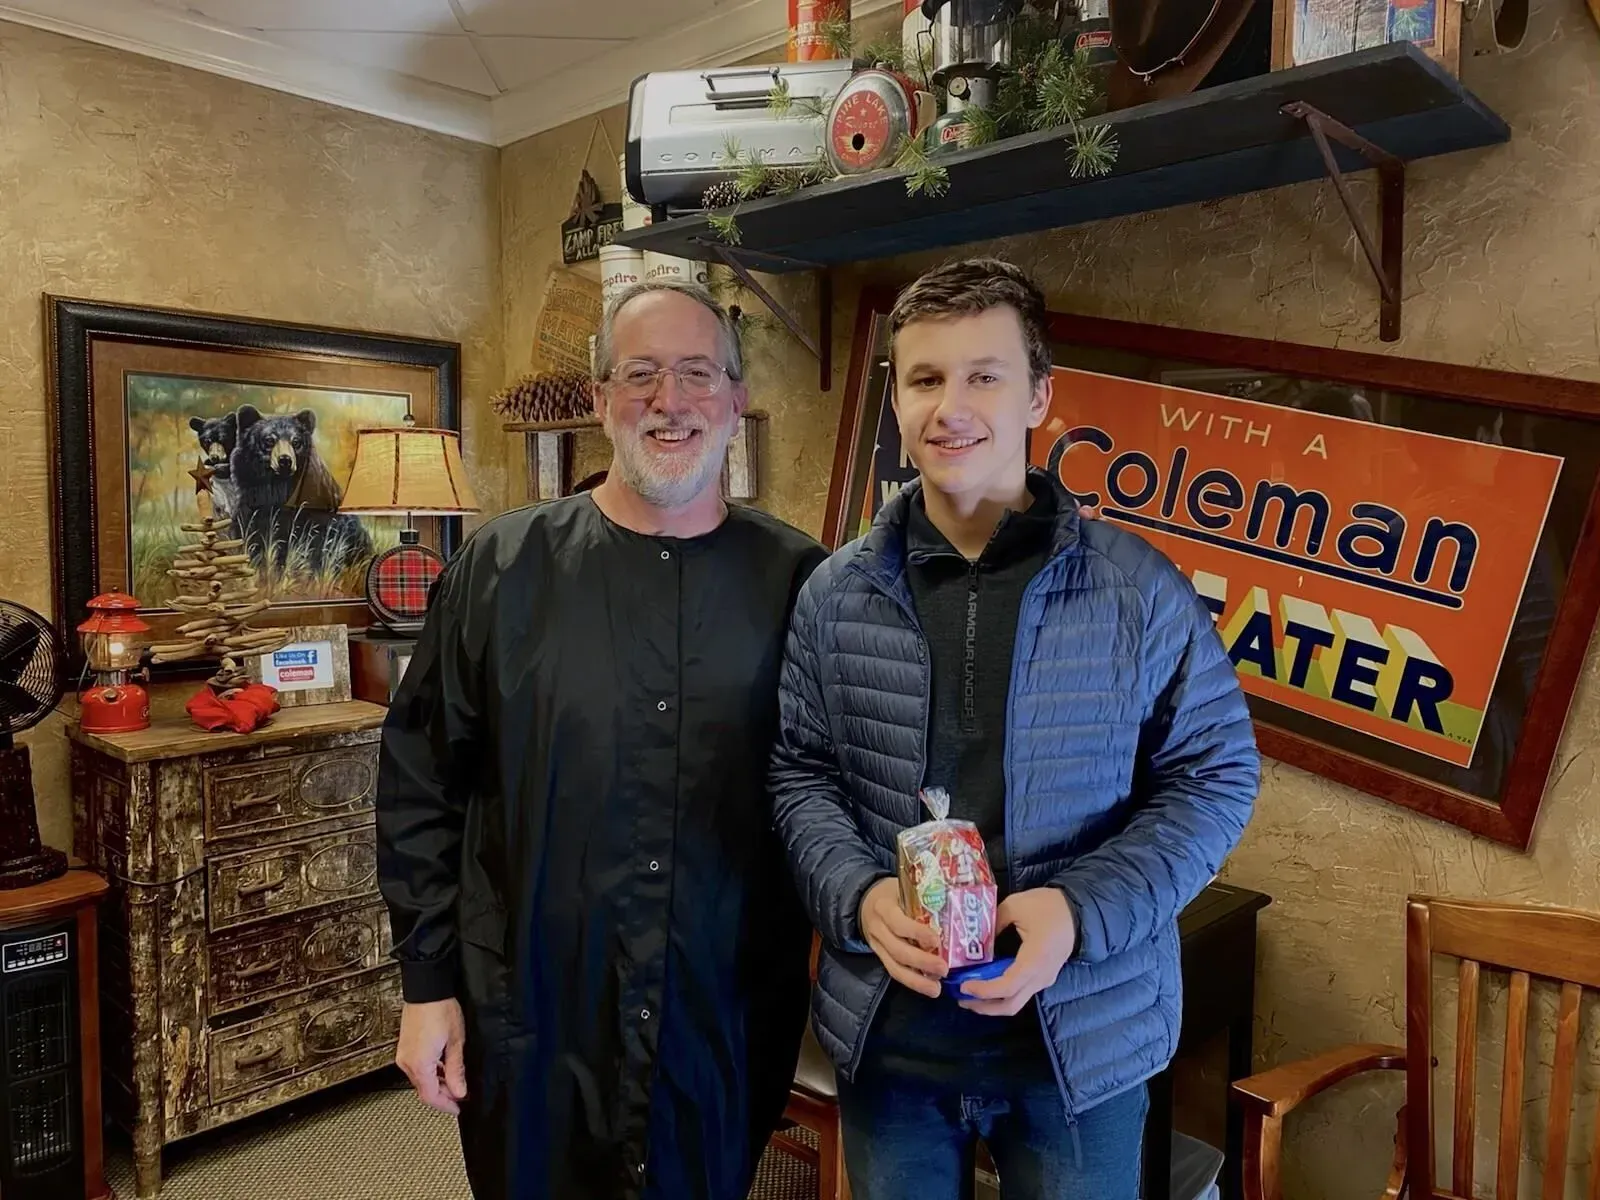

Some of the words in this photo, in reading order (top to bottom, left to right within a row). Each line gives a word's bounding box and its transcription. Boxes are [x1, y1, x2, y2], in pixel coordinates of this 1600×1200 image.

[837, 94, 860, 124] PINE
[865, 92, 888, 125] LAKE
[1159, 403, 1273, 448] WITH
[1301, 433, 1329, 460] A
[1046, 425, 1480, 594] Coleman
[965, 591, 978, 660] ARMOUR
[1197, 571, 1455, 736] ATER
[280, 669, 313, 678] coleman
[964, 662, 976, 718] UNDER
[963, 892, 986, 961] Extra
